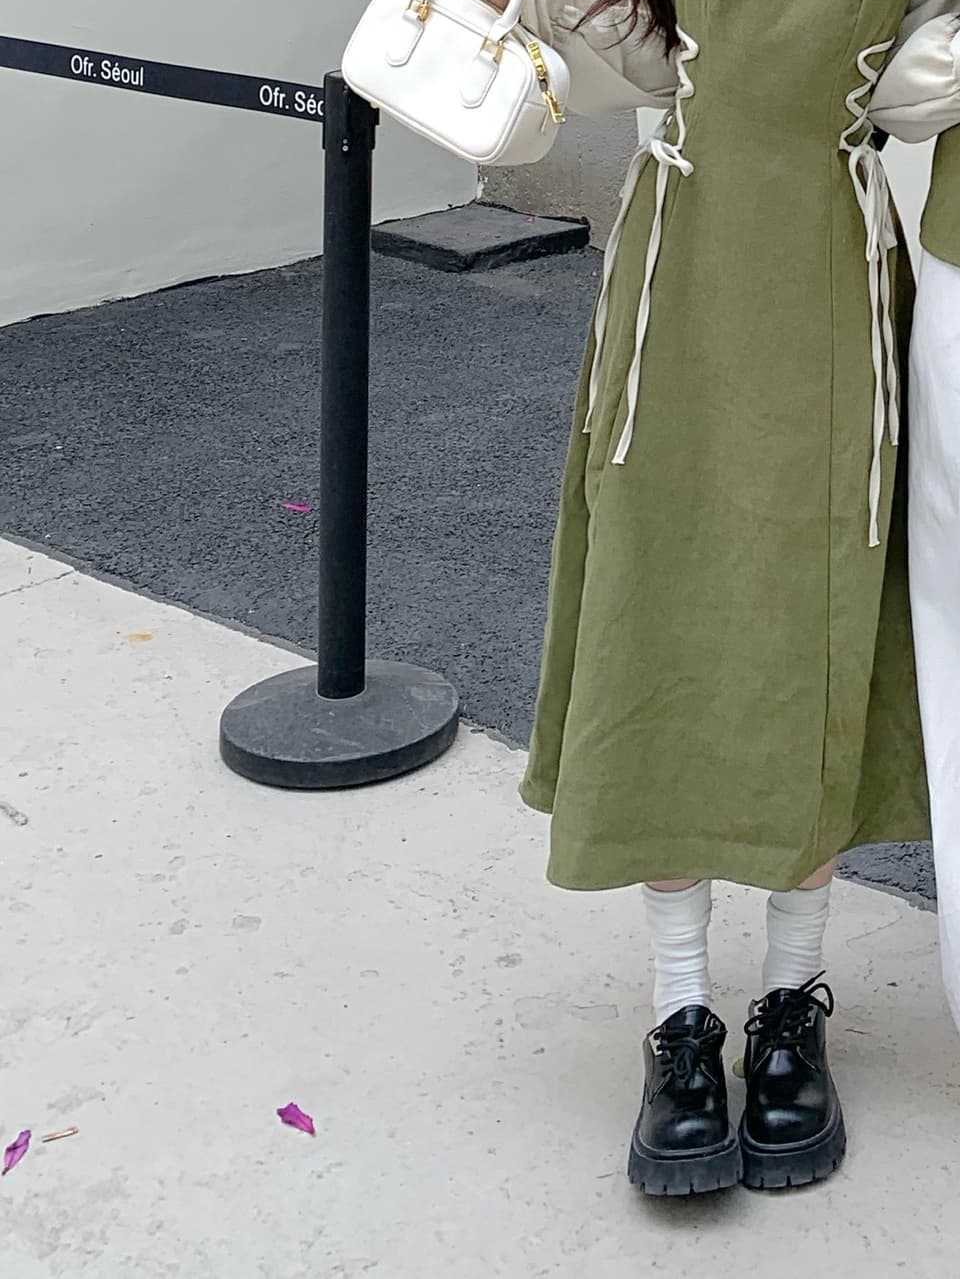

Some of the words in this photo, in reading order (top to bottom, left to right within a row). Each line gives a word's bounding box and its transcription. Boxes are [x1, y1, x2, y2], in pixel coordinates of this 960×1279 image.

[70, 54, 98, 78] Ofr.
[101, 60, 144, 87] Séoul
[259, 84, 289, 109] Ofr.
[294, 90, 324, 116] Séo
